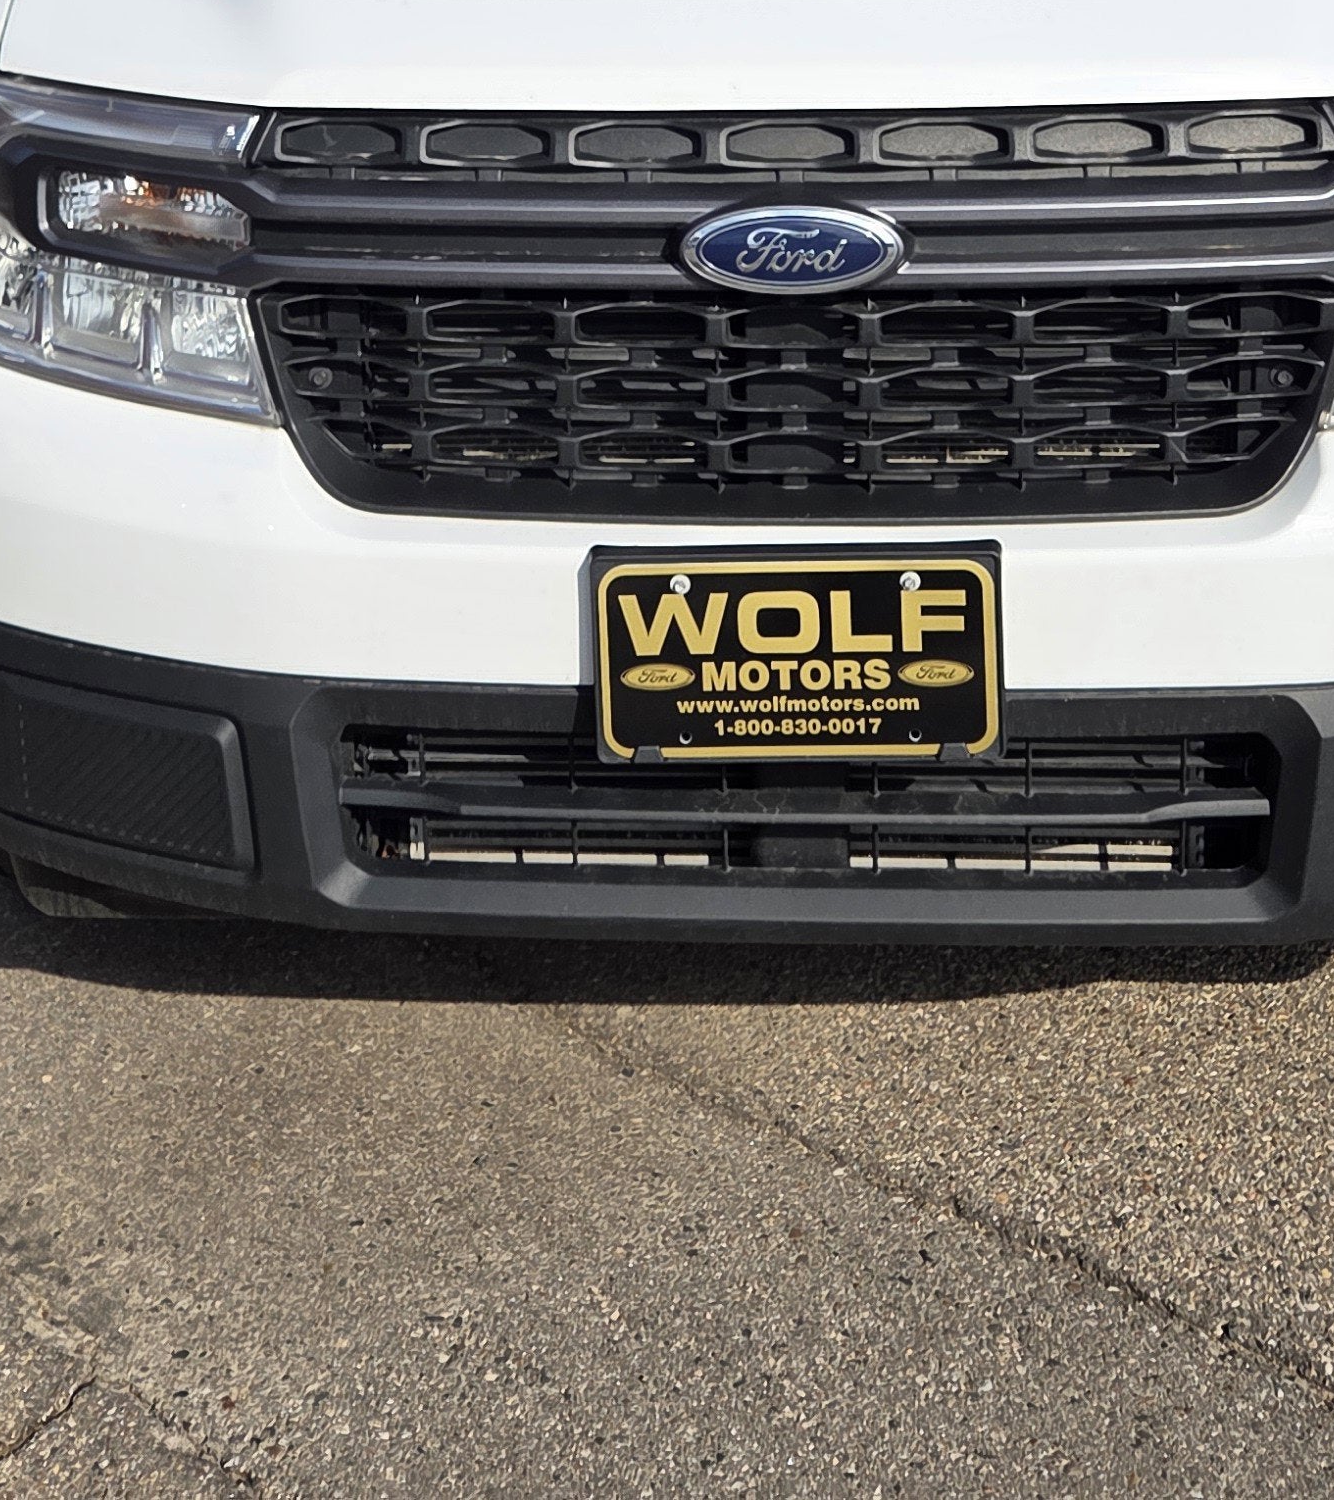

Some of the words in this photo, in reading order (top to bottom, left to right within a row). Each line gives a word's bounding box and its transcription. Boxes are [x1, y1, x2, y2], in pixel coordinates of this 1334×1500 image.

[736, 227, 848, 273] Ford
[618, 589, 966, 657] WOLF
[637, 669, 678, 684] Ford
[701, 659, 892, 692] MOTORS
[915, 665, 956, 680] Ford
[676, 696, 920, 714] www.wolfmotors.com
[713, 717, 883, 736] 1-800-830-0017
